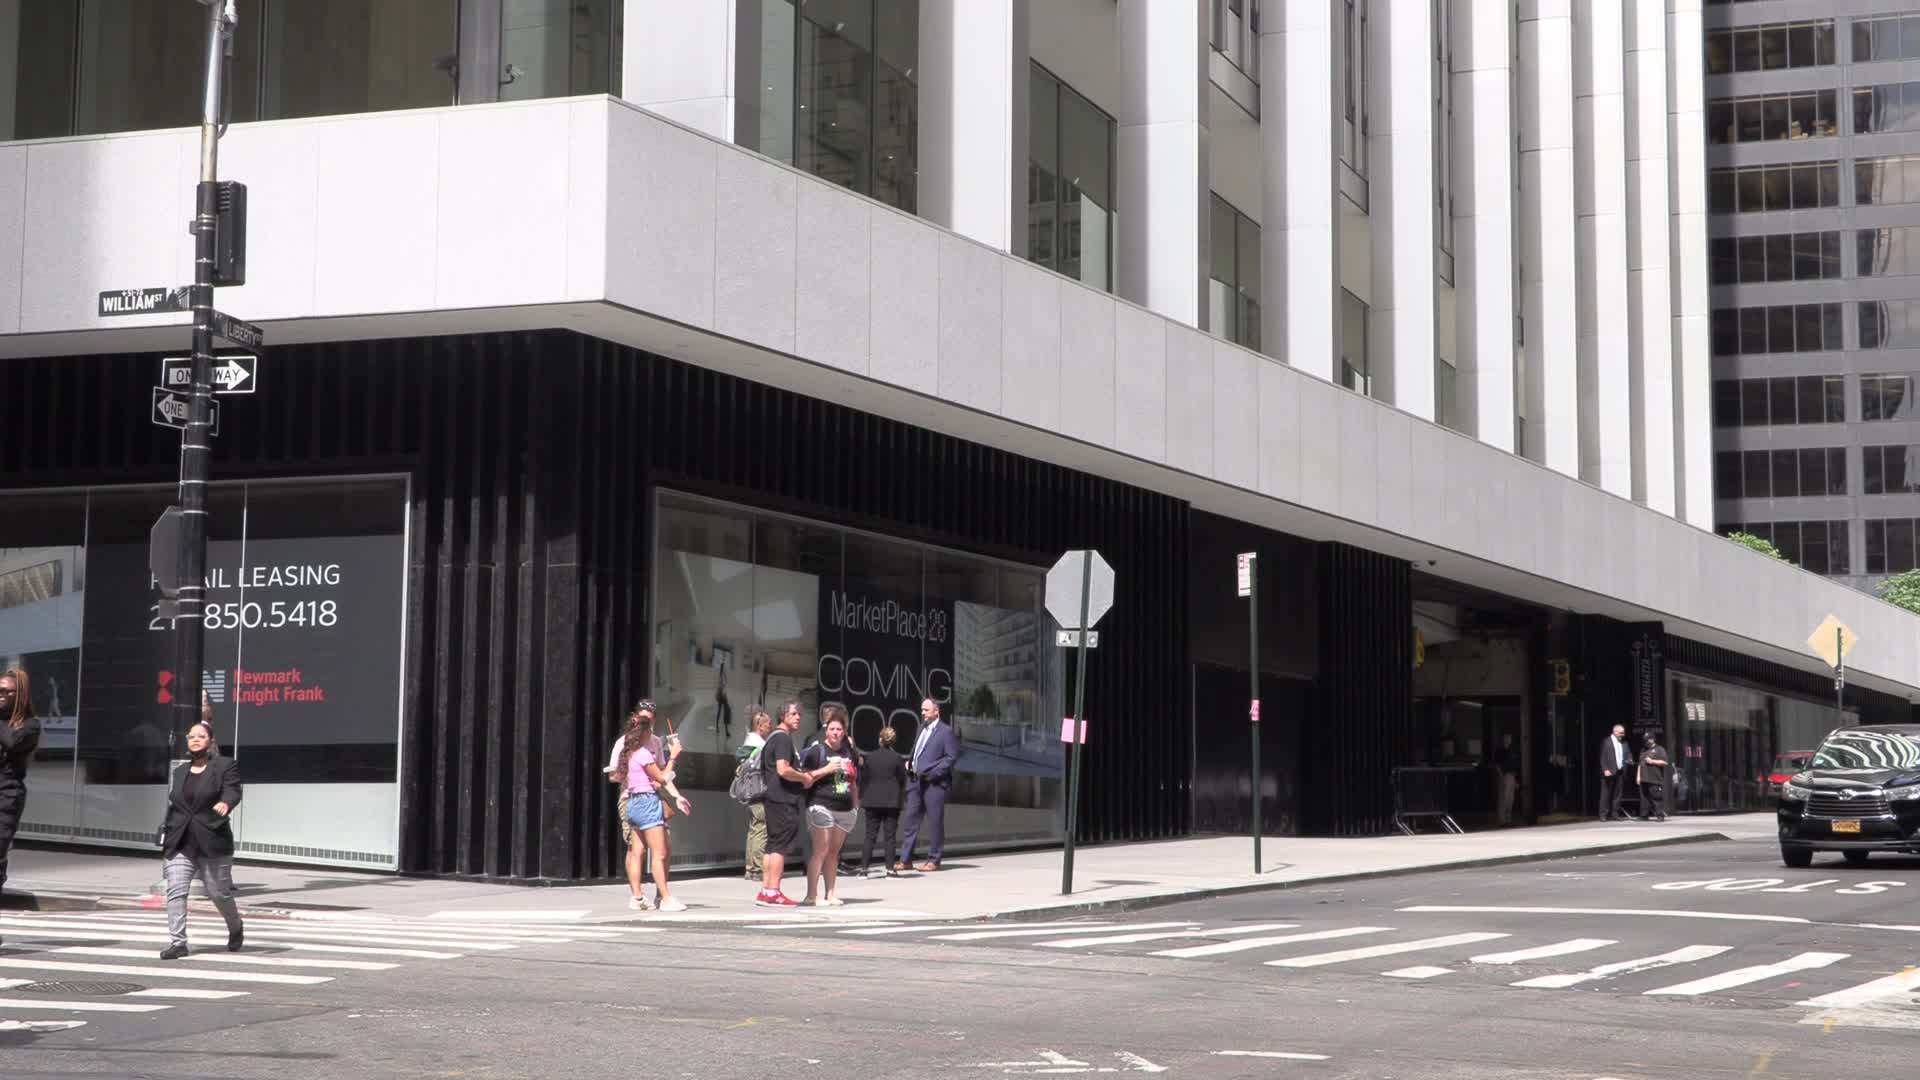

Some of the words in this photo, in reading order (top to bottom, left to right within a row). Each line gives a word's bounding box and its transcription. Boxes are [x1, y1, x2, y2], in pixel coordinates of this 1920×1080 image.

[102, 294, 155, 312] WILLIAM
[155, 293, 163, 302] ST
[228, 319, 256, 345] LIBERTY
[175, 369, 191, 382] ON
[215, 369, 240, 381] WAY
[163, 401, 184, 417] ONE
[238, 564, 341, 588] LEASING
[232, 668, 301, 685] Newmark
[818, 654, 952, 704] COMING
[232, 686, 280, 706] Knight
[283, 686, 324, 702] Frank
